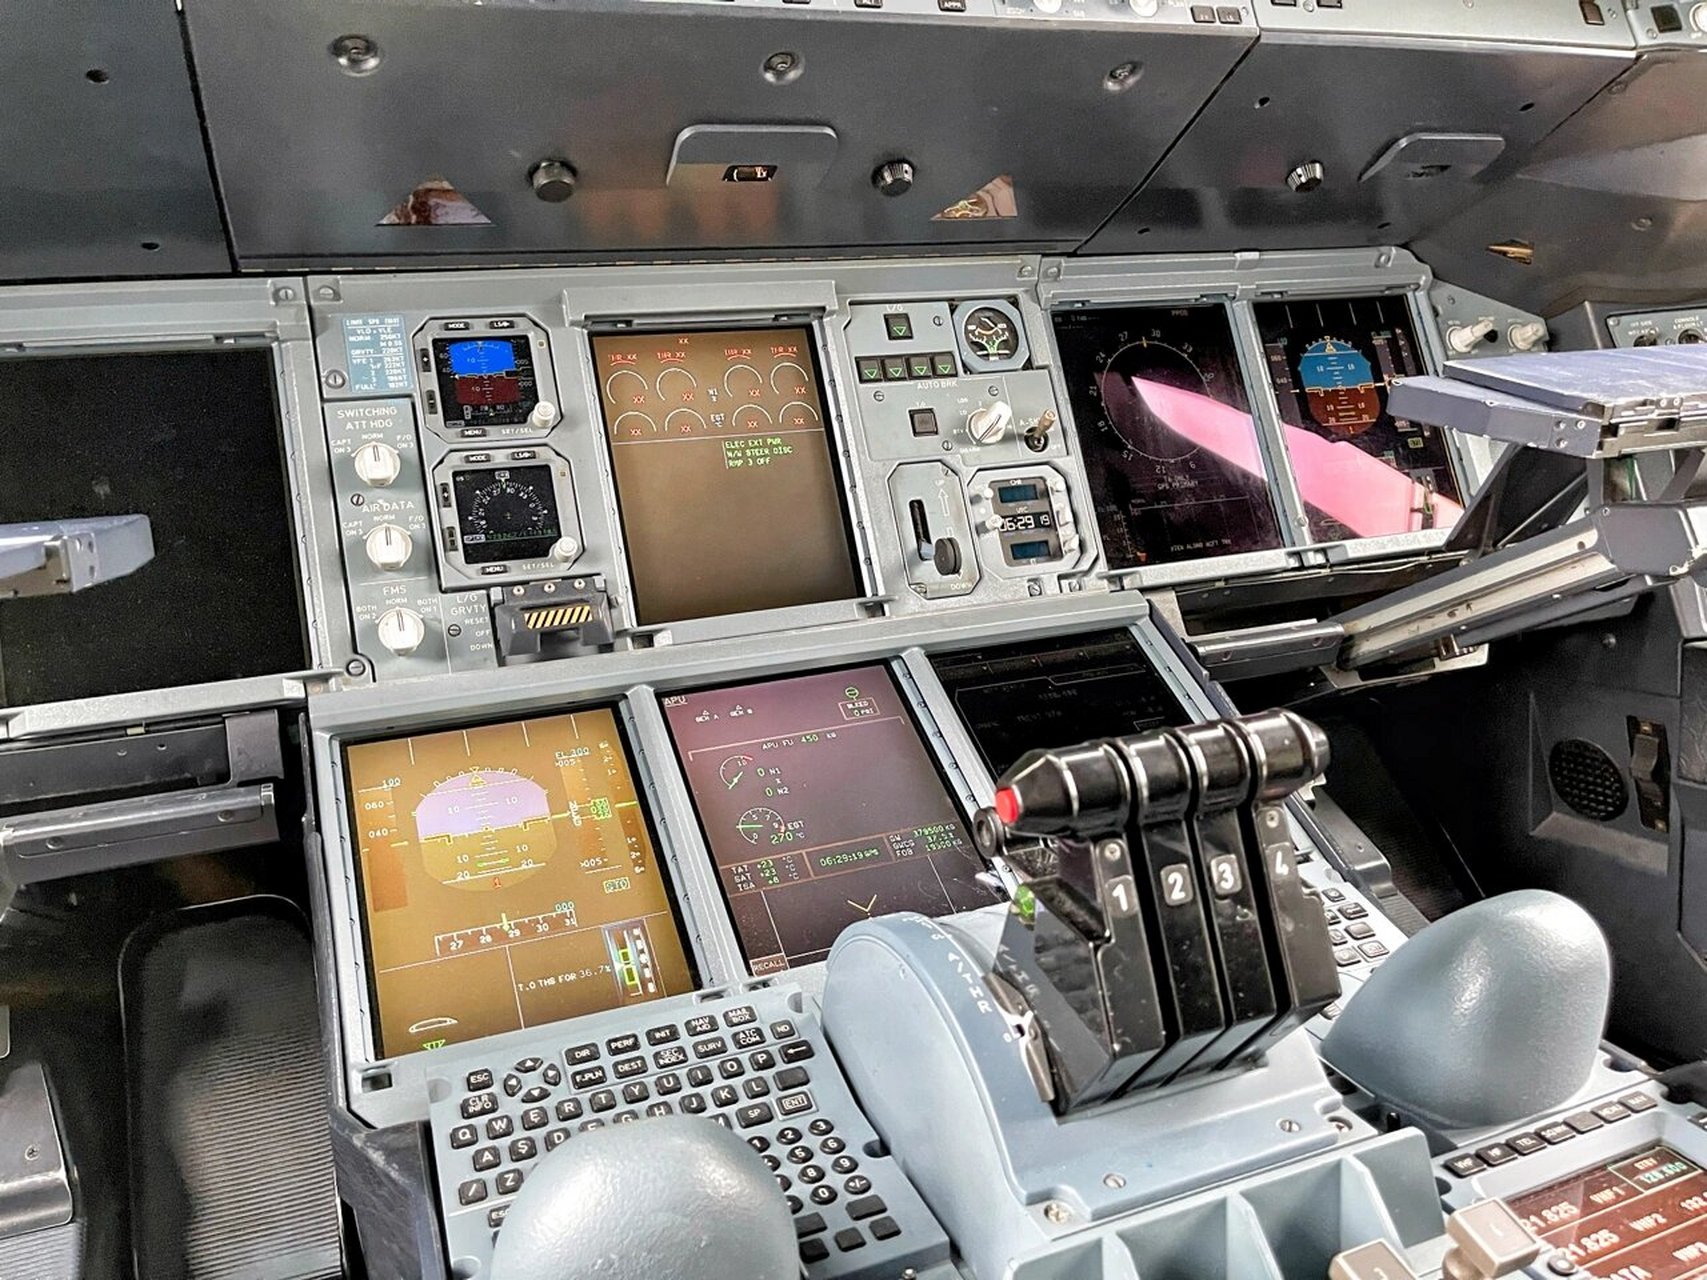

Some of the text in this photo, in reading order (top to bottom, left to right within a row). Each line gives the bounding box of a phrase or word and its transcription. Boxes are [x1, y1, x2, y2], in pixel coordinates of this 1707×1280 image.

[337, 406, 397, 419] SWITCHING
[345, 419, 393, 430] ATT HDG
[725, 440, 746, 449] ELEC
[749, 439, 765, 447] EXT
[746, 447, 771, 457] STEER
[773, 446, 793, 454] DISC
[756, 457, 771, 465] OFF
[362, 500, 415, 513] AIR DATA
[373, 514, 395, 522] NORM
[383, 584, 407, 596] FMS
[385, 597, 408, 605] NORM
[457, 593, 478, 604] L/G
[451, 604, 487, 616] GRVTY
[464, 617, 489, 625] RESET
[475, 629, 491, 638] OFF
[470, 643, 493, 651] DOWN
[664, 695, 687, 706] APU
[762, 734, 819, 750] APU 450
[777, 787, 790, 796] N2
[505, 796, 518, 805] 10
[447, 806, 460, 814] 10
[368, 828, 389, 839] 040
[770, 831, 794, 844] 270
[516, 844, 528, 853] 10
[457, 854, 469, 864] 10
[1274, 851, 1289, 876] 4
[731, 864, 750, 875] TAT
[457, 871, 470, 880] 20
[1218, 862, 1234, 890] 3
[1167, 872, 1185, 900] 2
[1112, 884, 1128, 912] 1
[535, 923, 549, 932] 30
[507, 929, 520, 938] 29
[450, 939, 463, 950] 27
[752, 960, 786, 973] RECALL
[558, 972, 577, 982] FOR
[691, 1017, 710, 1027] NAV
[654, 1029, 671, 1039] INIT
[610, 1037, 635, 1050] PERF
[698, 1041, 723, 1053] SURV
[574, 1049, 591, 1059] DIR
[758, 1054, 767, 1064] P
[618, 1061, 642, 1072] DEST
[726, 1061, 738, 1072] O
[470, 1072, 490, 1084] ESC
[663, 1077, 674, 1087] U
[630, 1085, 640, 1095] Y
[752, 1081, 762, 1091] L
[597, 1094, 607, 1104] T
[720, 1088, 731, 1099] K
[469, 1094, 489, 1106] CLR
[690, 1097, 698, 1108] J
[468, 1102, 492, 1113] INFO
[564, 1102, 574, 1113] R
[655, 1105, 665, 1116] H
[748, 1109, 761, 1120] SP
[816, 1121, 826, 1130] 3
[458, 1128, 471, 1140] Q
[553, 1132, 564, 1144] D
[784, 1129, 795, 1139] 2
[752, 1139, 761, 1148] 1
[827, 1140, 838, 1149] 6
[1516, 1137, 1536, 1148] TEL
[482, 1151, 493, 1162] A
[795, 1148, 805, 1158] 5
[1488, 1148, 1502, 1157] HF
[839, 1158, 850, 1168] 9
[1454, 1158, 1473, 1170] VHF
[806, 1168, 817, 1178] 8
[504, 1174, 515, 1187] Z
[818, 1189, 829, 1199] 0
[1589, 1186, 1626, 1204] VHF1
[1628, 1213, 1668, 1232] VHF2
